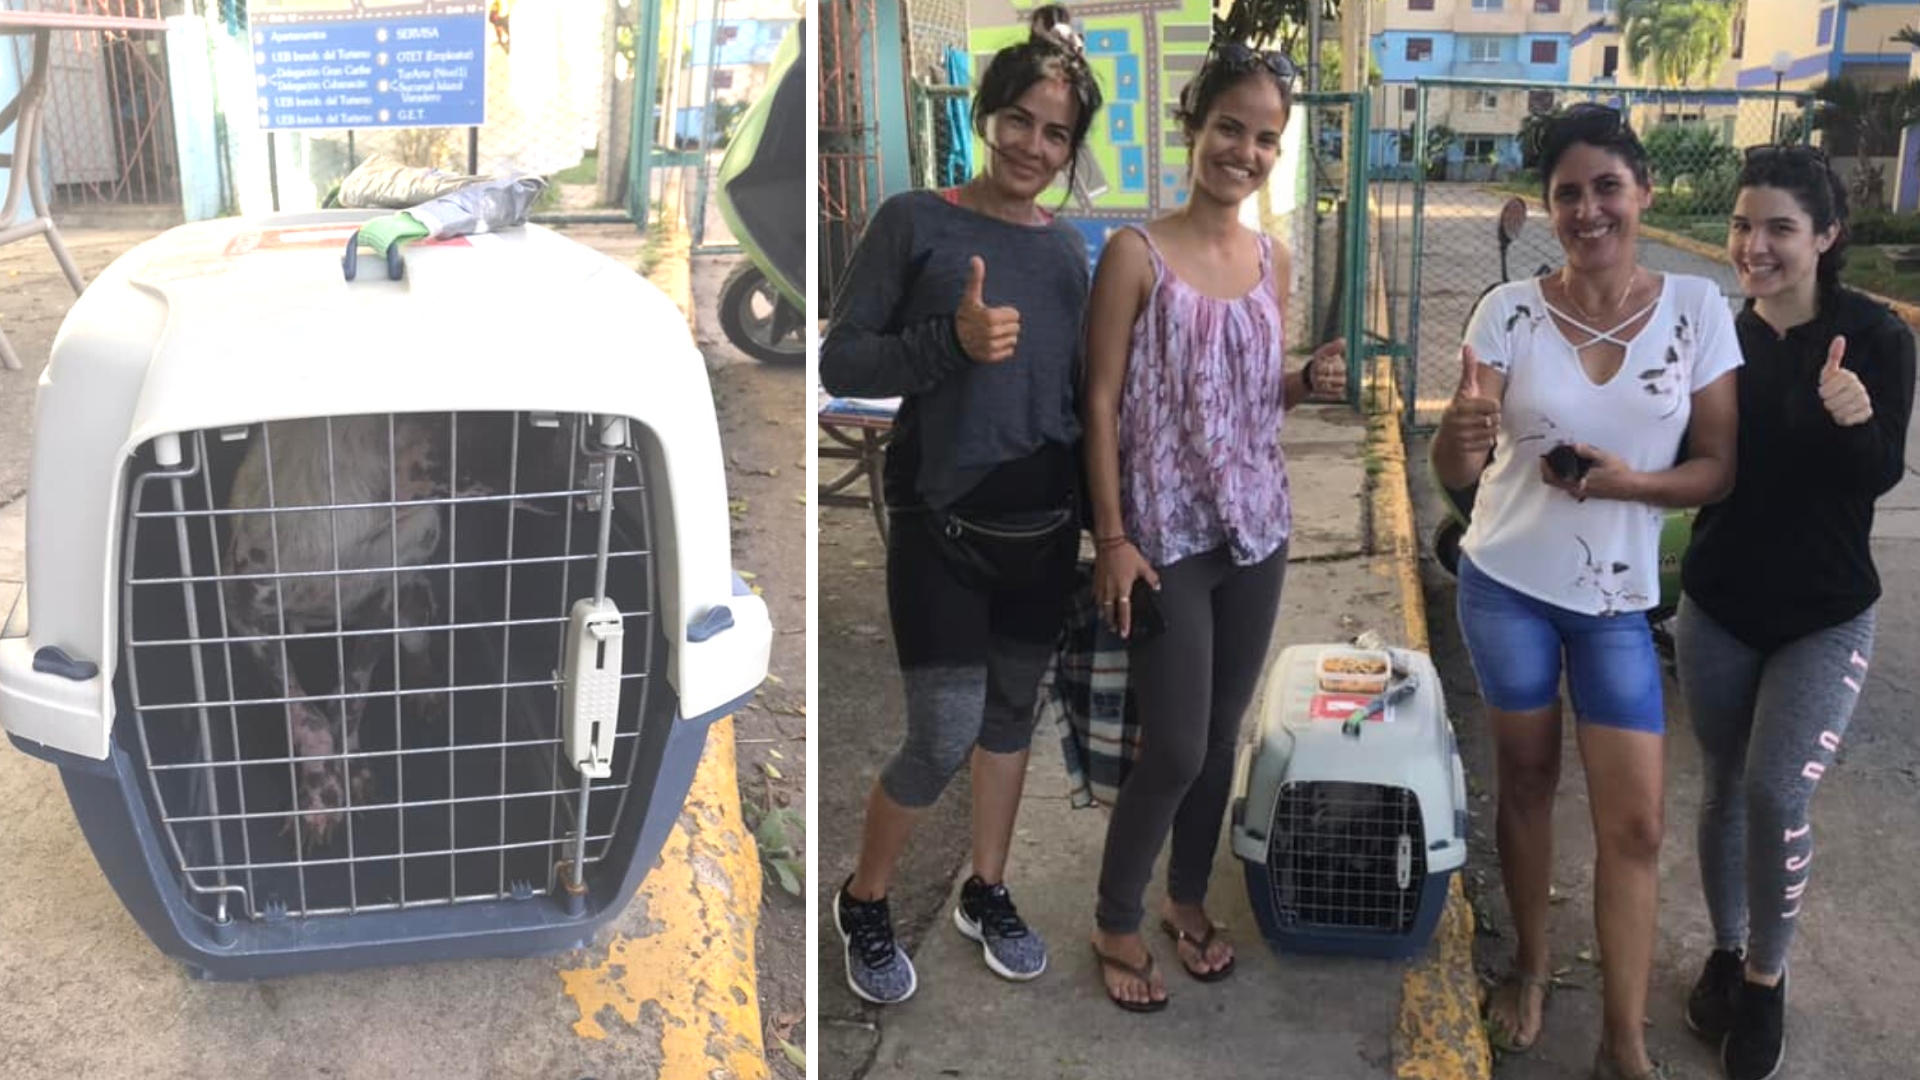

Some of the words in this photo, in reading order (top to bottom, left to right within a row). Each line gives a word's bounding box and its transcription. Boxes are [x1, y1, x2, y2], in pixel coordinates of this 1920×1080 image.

[396, 26, 440, 40] SERVISA
[1780, 823, 1813, 919] JUST
[1801, 729, 1842, 780] DO
[1842, 649, 1869, 693] IT
